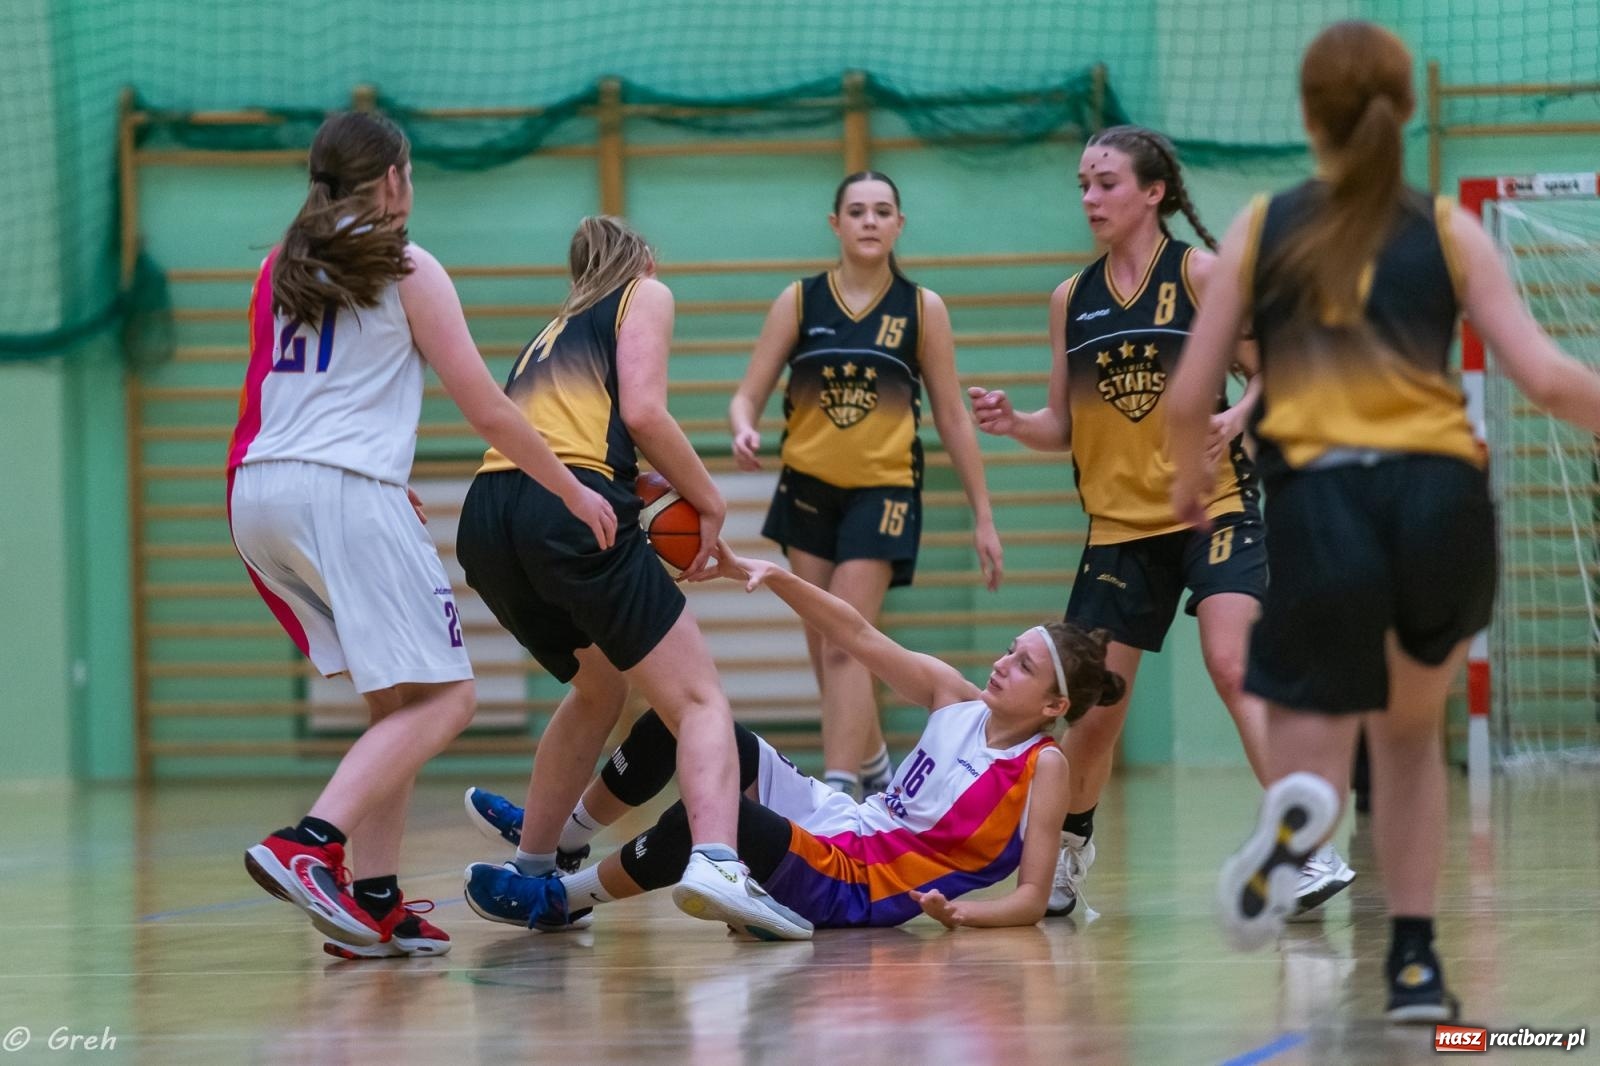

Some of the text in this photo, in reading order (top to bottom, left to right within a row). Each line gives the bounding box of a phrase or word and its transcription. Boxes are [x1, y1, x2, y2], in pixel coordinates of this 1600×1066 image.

[1153, 282, 1177, 326] 8
[875, 314, 908, 348] 15
[819, 388, 879, 409] STARS
[1098, 371, 1168, 400] STARS
[879, 499, 909, 536] 15
[1208, 525, 1235, 565] 8
[902, 748, 936, 799] 16
